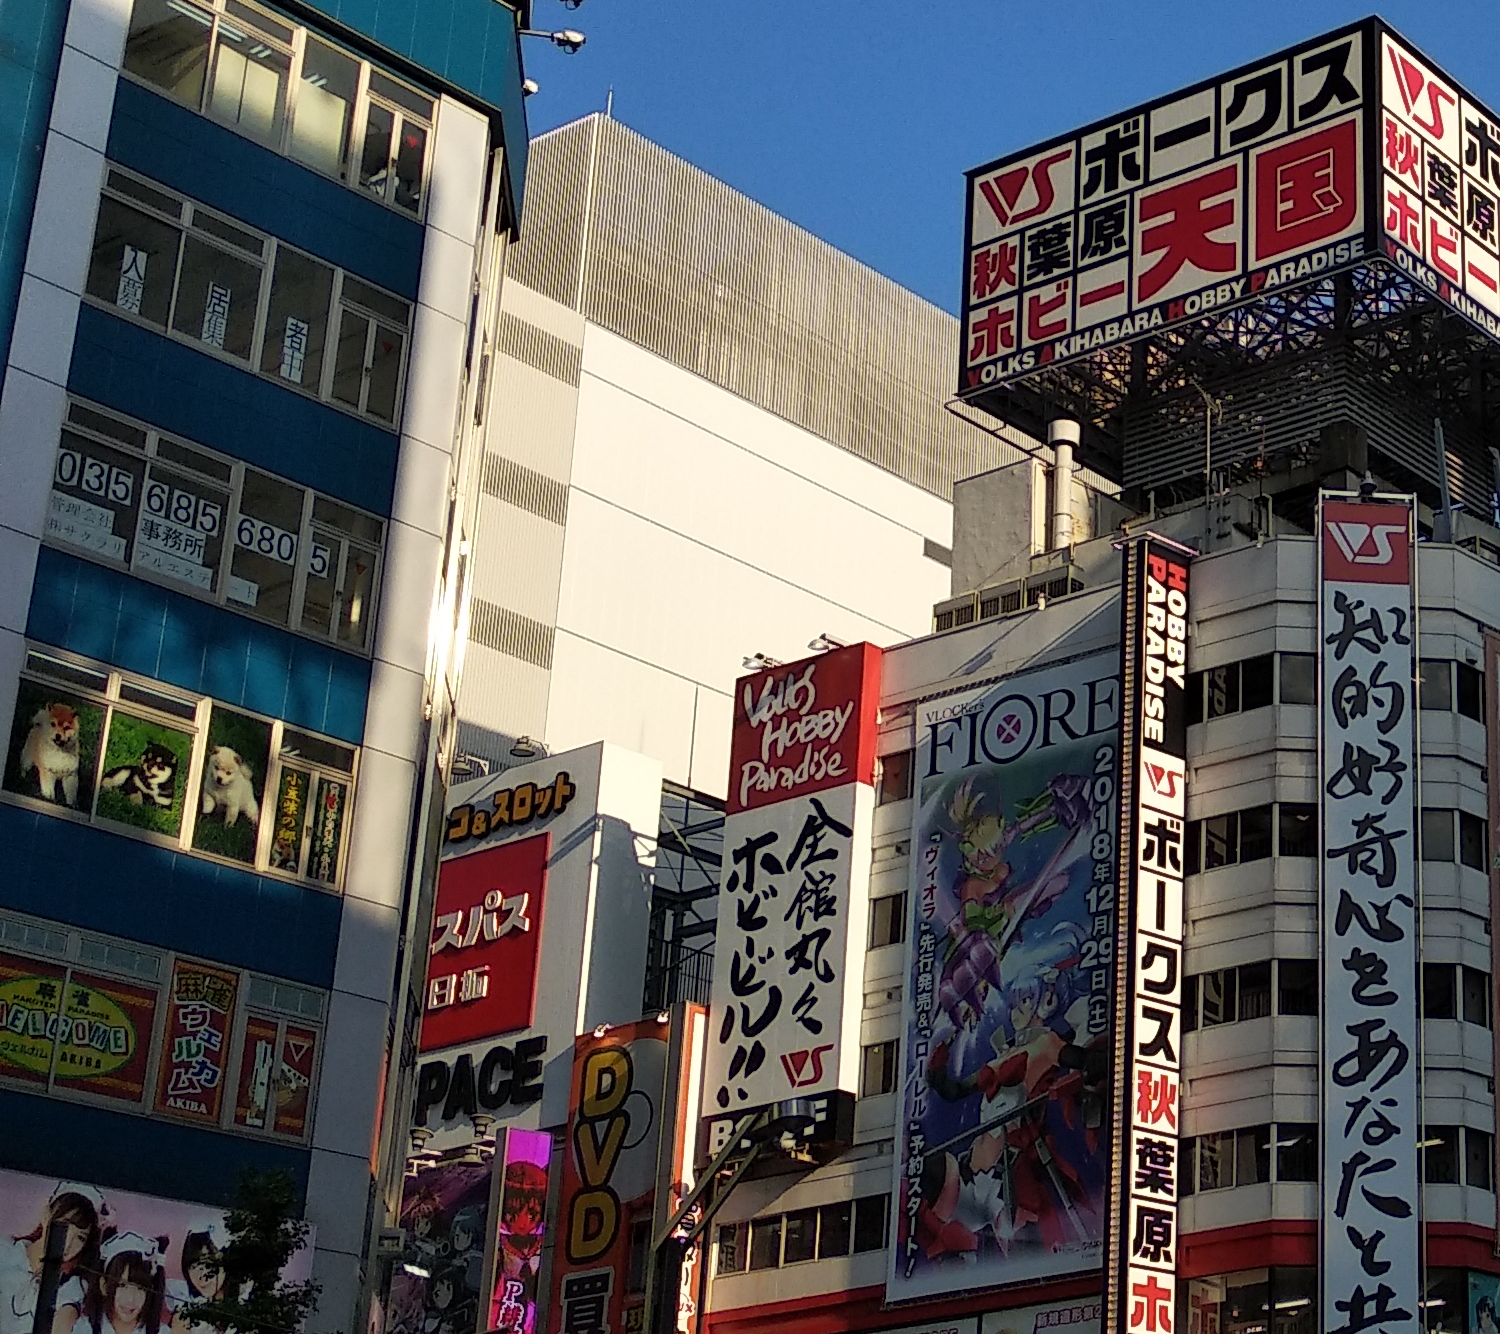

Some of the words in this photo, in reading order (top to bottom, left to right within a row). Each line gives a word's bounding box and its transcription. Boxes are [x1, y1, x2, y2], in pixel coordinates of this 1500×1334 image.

[1083, 41, 1360, 199] ボークス
[1139, 119, 1357, 304] 天国
[1384, 112, 1497, 248] 秋葉原
[972, 204, 1127, 301] 秋葉原
[1384, 188, 1497, 295] ホビー
[1385, 239, 1437, 290] VOLKS
[968, 352, 1035, 387] VOLKS
[1040, 309, 1164, 364] AKIHABARA
[1167, 280, 1244, 321] HOBBY
[1251, 240, 1365, 293] PARADISE
[972, 280, 1125, 363] ホビー
[142, 518, 203, 558] 事務所
[1143, 553, 1168, 743] PARADISE
[1168, 562, 1187, 690] HOBBY
[923, 674, 1120, 779] FIORE
[739, 752, 849, 810] Paradise
[0, 1000, 127, 1054] ELCOME
[60, 1052, 101, 1069] AKIBA
[166, 1097, 207, 1114] AKIBA
[416, 1036, 547, 1124] PACE
